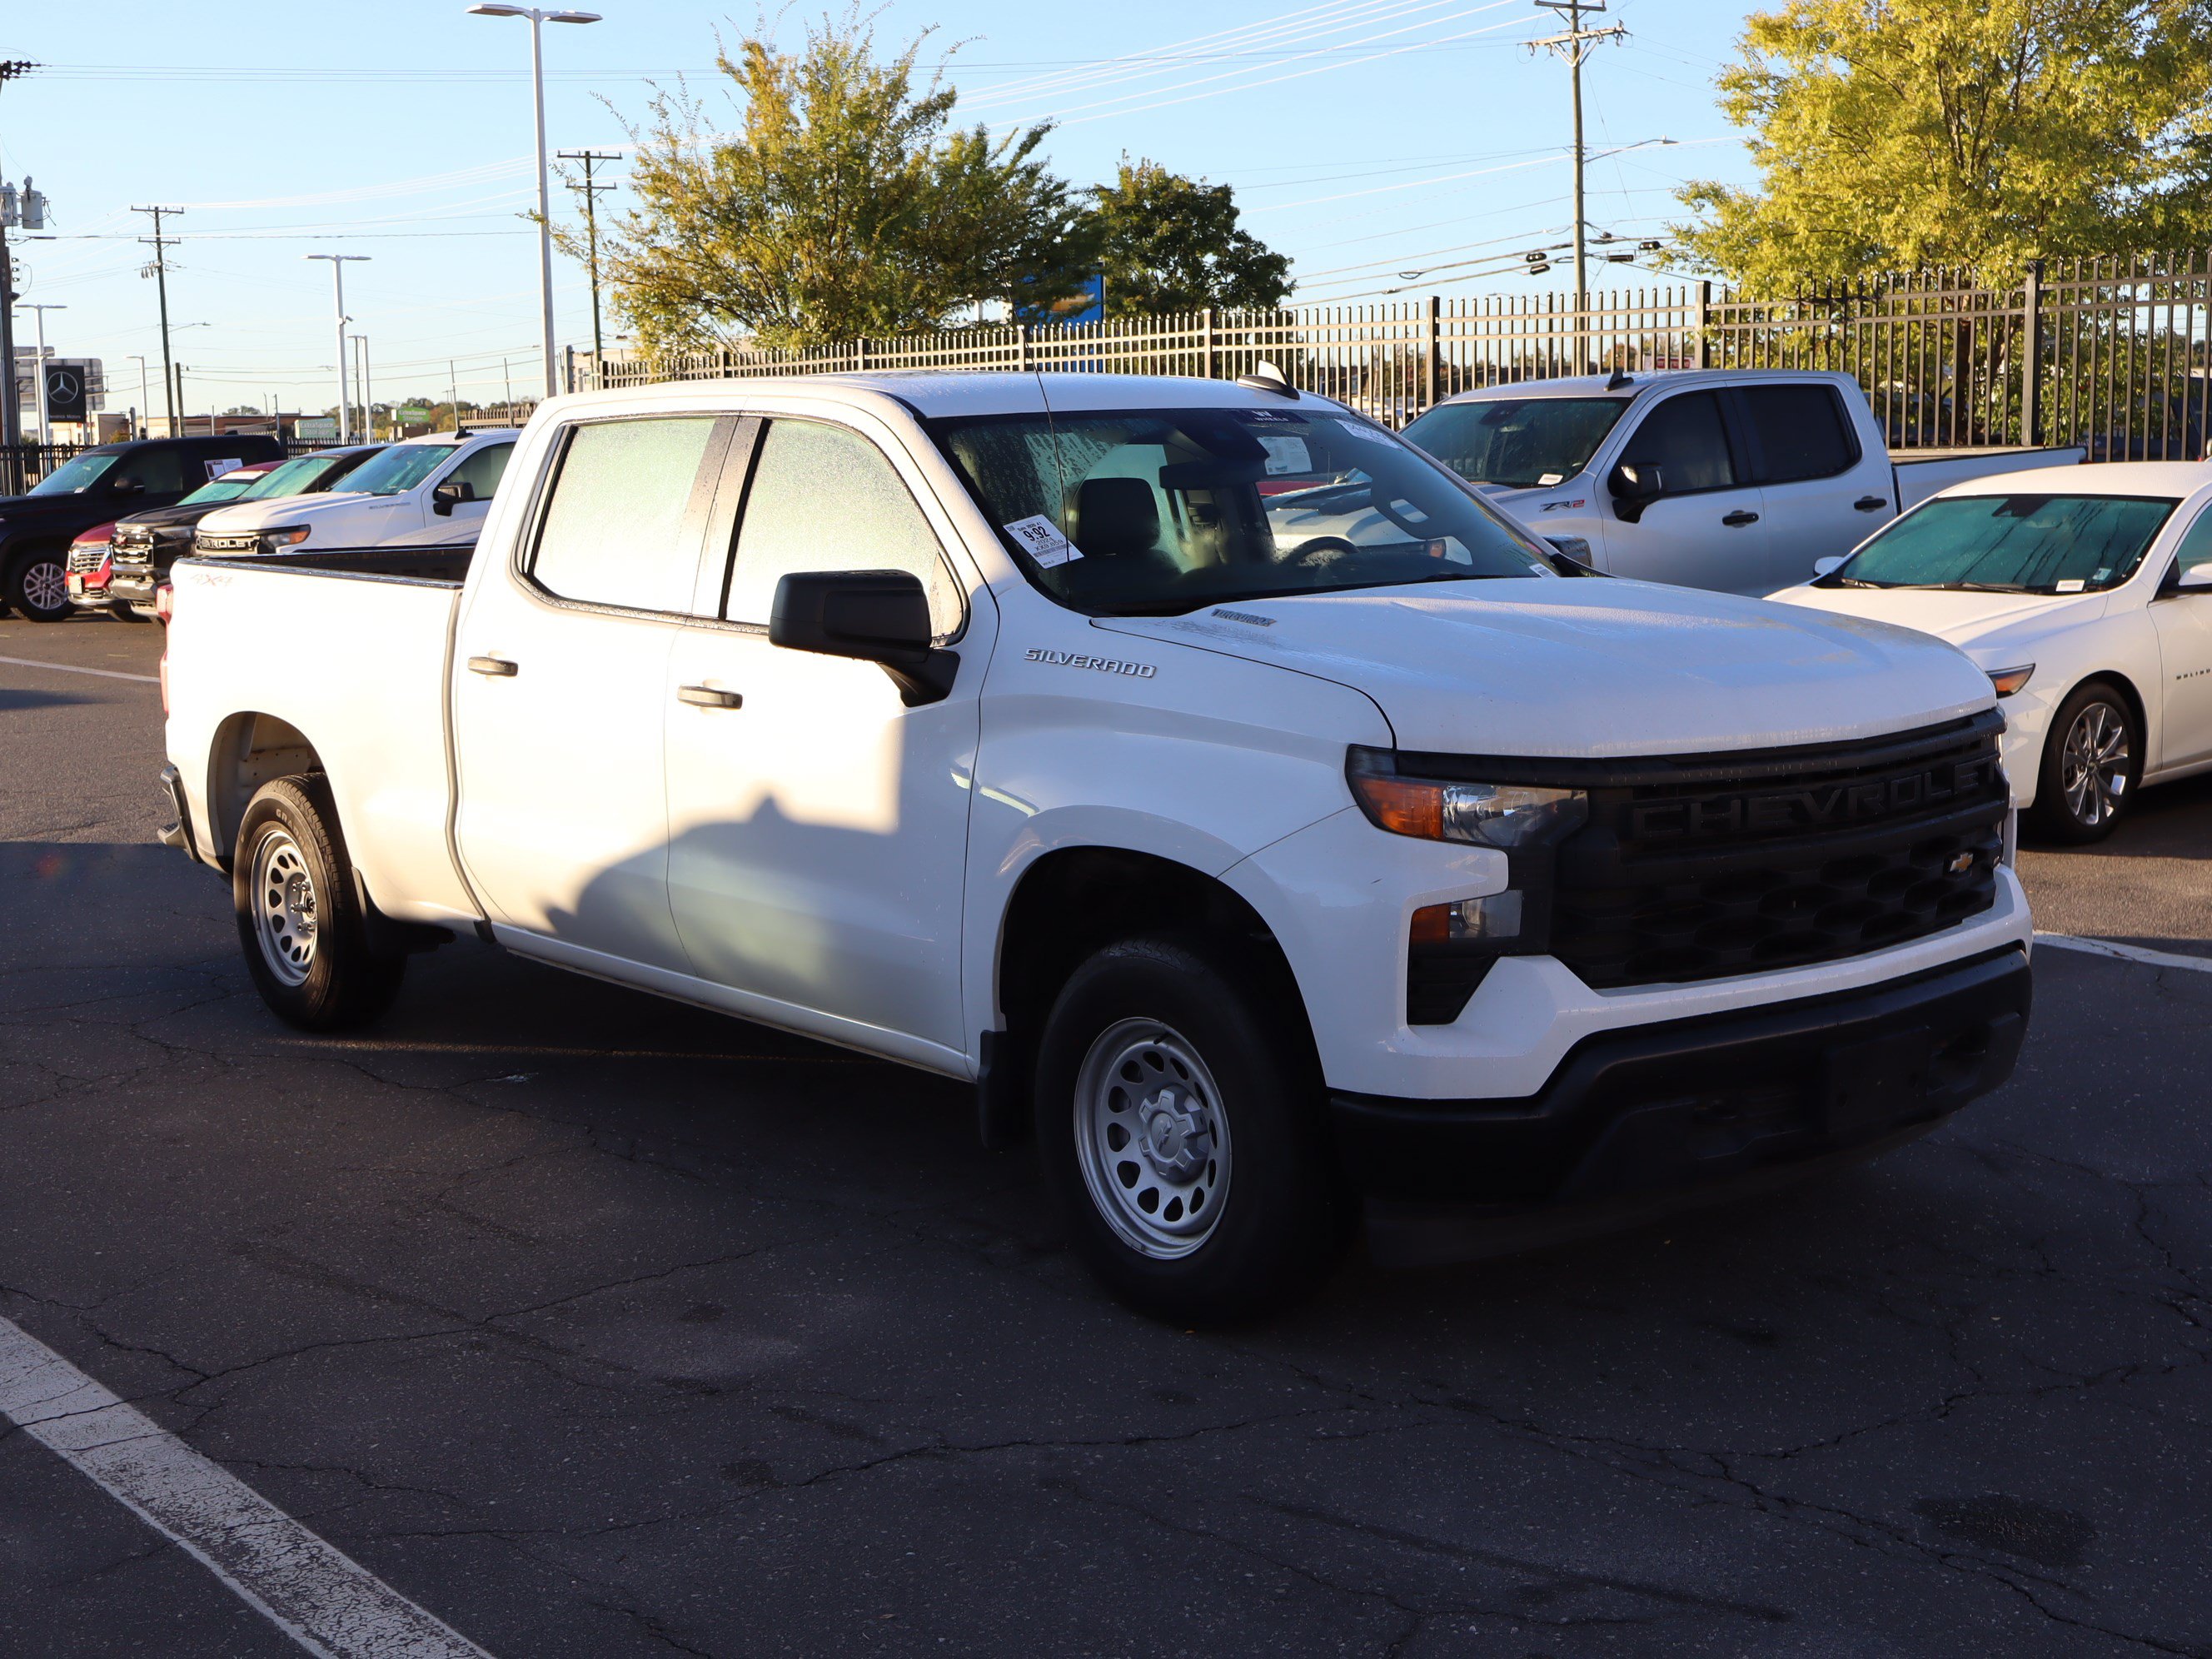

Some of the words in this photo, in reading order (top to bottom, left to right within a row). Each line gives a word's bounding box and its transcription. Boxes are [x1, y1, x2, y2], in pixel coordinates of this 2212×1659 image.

[1539, 499, 1586, 513] ZR2
[1023, 526, 1050, 541] 9:92
[1035, 537, 1054, 546] 2024
[1024, 648, 1157, 678] SILVERADO
[2176, 669, 2211, 680] MALIBU
[1632, 753, 2001, 835] CHEVROLET
